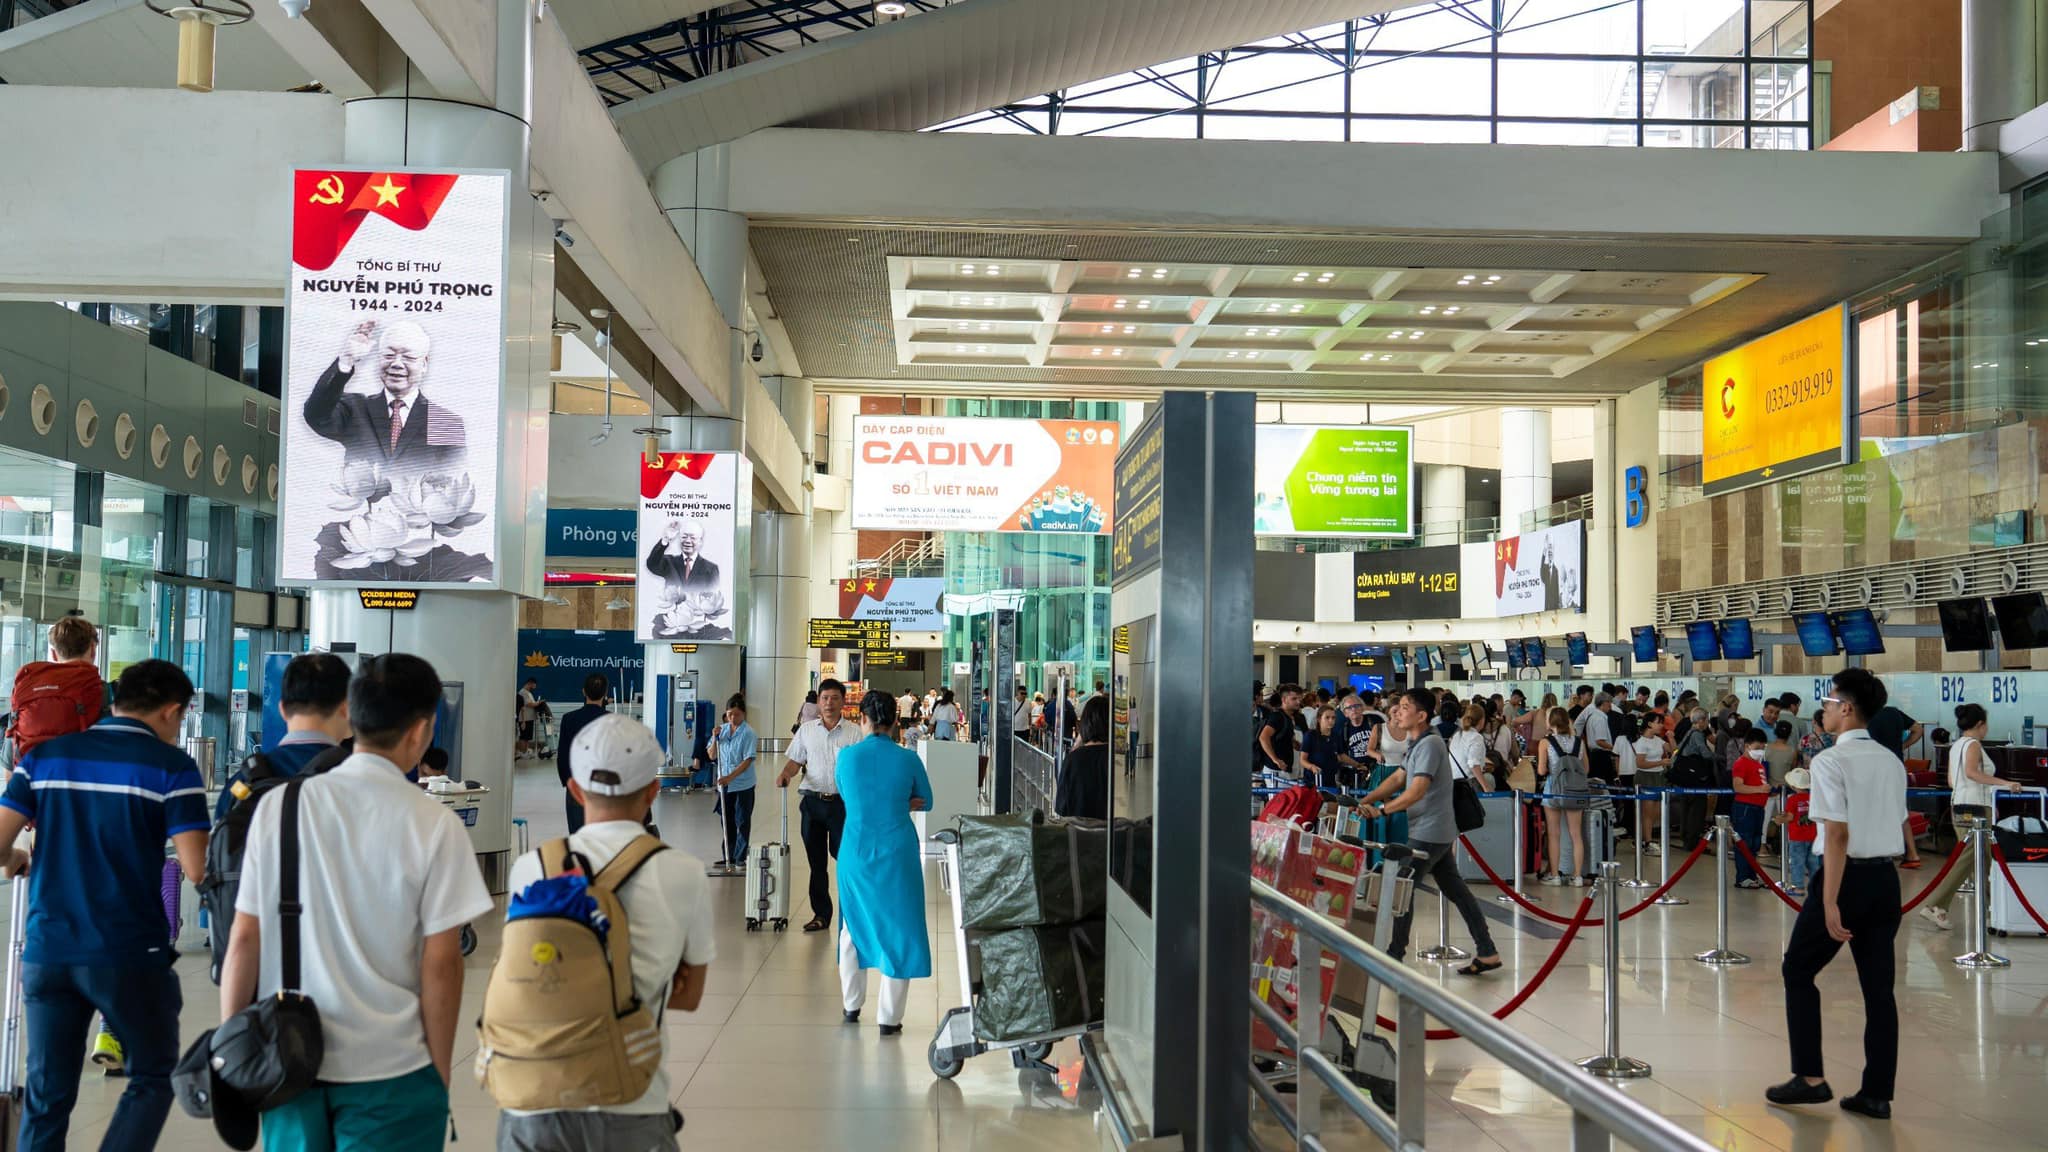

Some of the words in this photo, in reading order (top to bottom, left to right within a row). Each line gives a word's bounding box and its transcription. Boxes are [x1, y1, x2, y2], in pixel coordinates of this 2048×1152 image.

[356, 258, 394, 272] TỔNG
[398, 259, 410, 272] BÍ
[413, 261, 442, 273] THƯ
[303, 274, 379, 294] NGUYỄN
[385, 279, 424, 295] PHÚ
[429, 283, 493, 300] TRỌNG
[350, 298, 388, 311] 1944
[404, 300, 443, 312] 2024
[1766, 368, 1832, 414] 0332.919.919
[862, 440, 1013, 467] CADIVI
[1306, 471, 1344, 484] Chung
[966, 486, 999, 497] NAM
[1383, 484, 1397, 496] lai
[1625, 465, 1649, 529] B
[645, 501, 679, 509] NGUYỄN
[682, 502, 700, 510] PHÚ
[563, 525, 617, 545] Phòng
[1041, 521, 1079, 530] cadivi.vn
[1373, 574, 1384, 586] RA
[1401, 572, 1416, 585] BAY
[1419, 573, 1442, 593] 1-12
[550, 655, 603, 668] Vietnam
[603, 655, 645, 668] Airline
[1748, 679, 1764, 700] B09
[1815, 679, 1832, 700] B10
[1941, 676, 1965, 702] B12
[1992, 676, 2018, 703] B13
